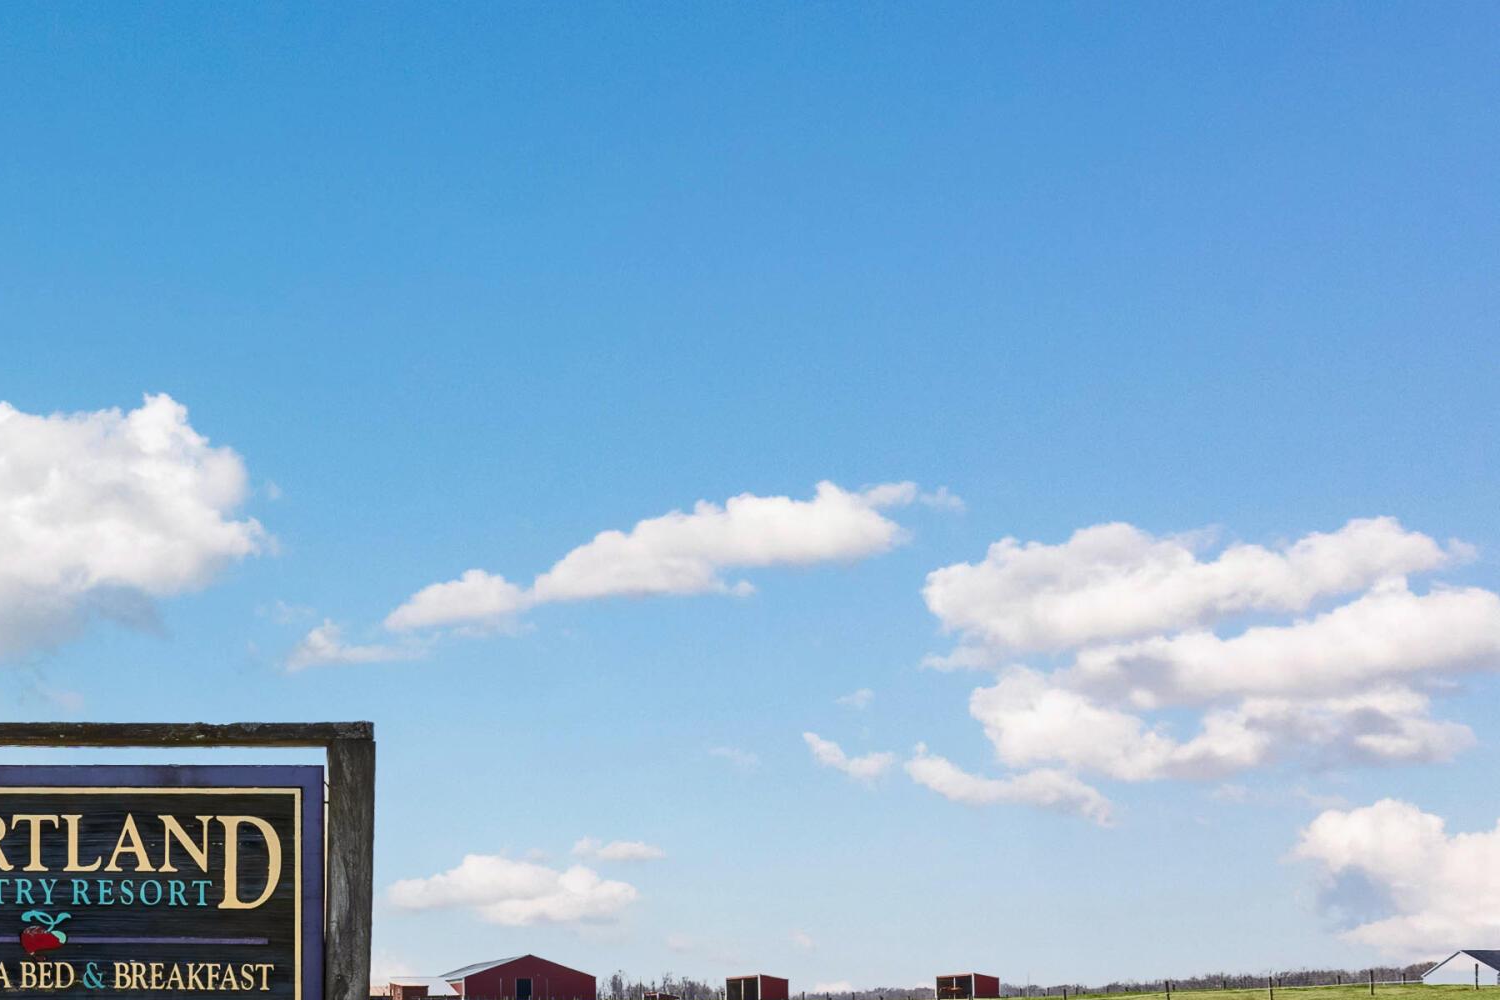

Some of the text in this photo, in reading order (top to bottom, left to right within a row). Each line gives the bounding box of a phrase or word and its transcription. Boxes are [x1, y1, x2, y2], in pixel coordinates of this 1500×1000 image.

[71, 879, 213, 906] RESORT
[20, 961, 75, 989] BED
[83, 962, 105, 989] &
[114, 961, 275, 991] BREAKFAST
